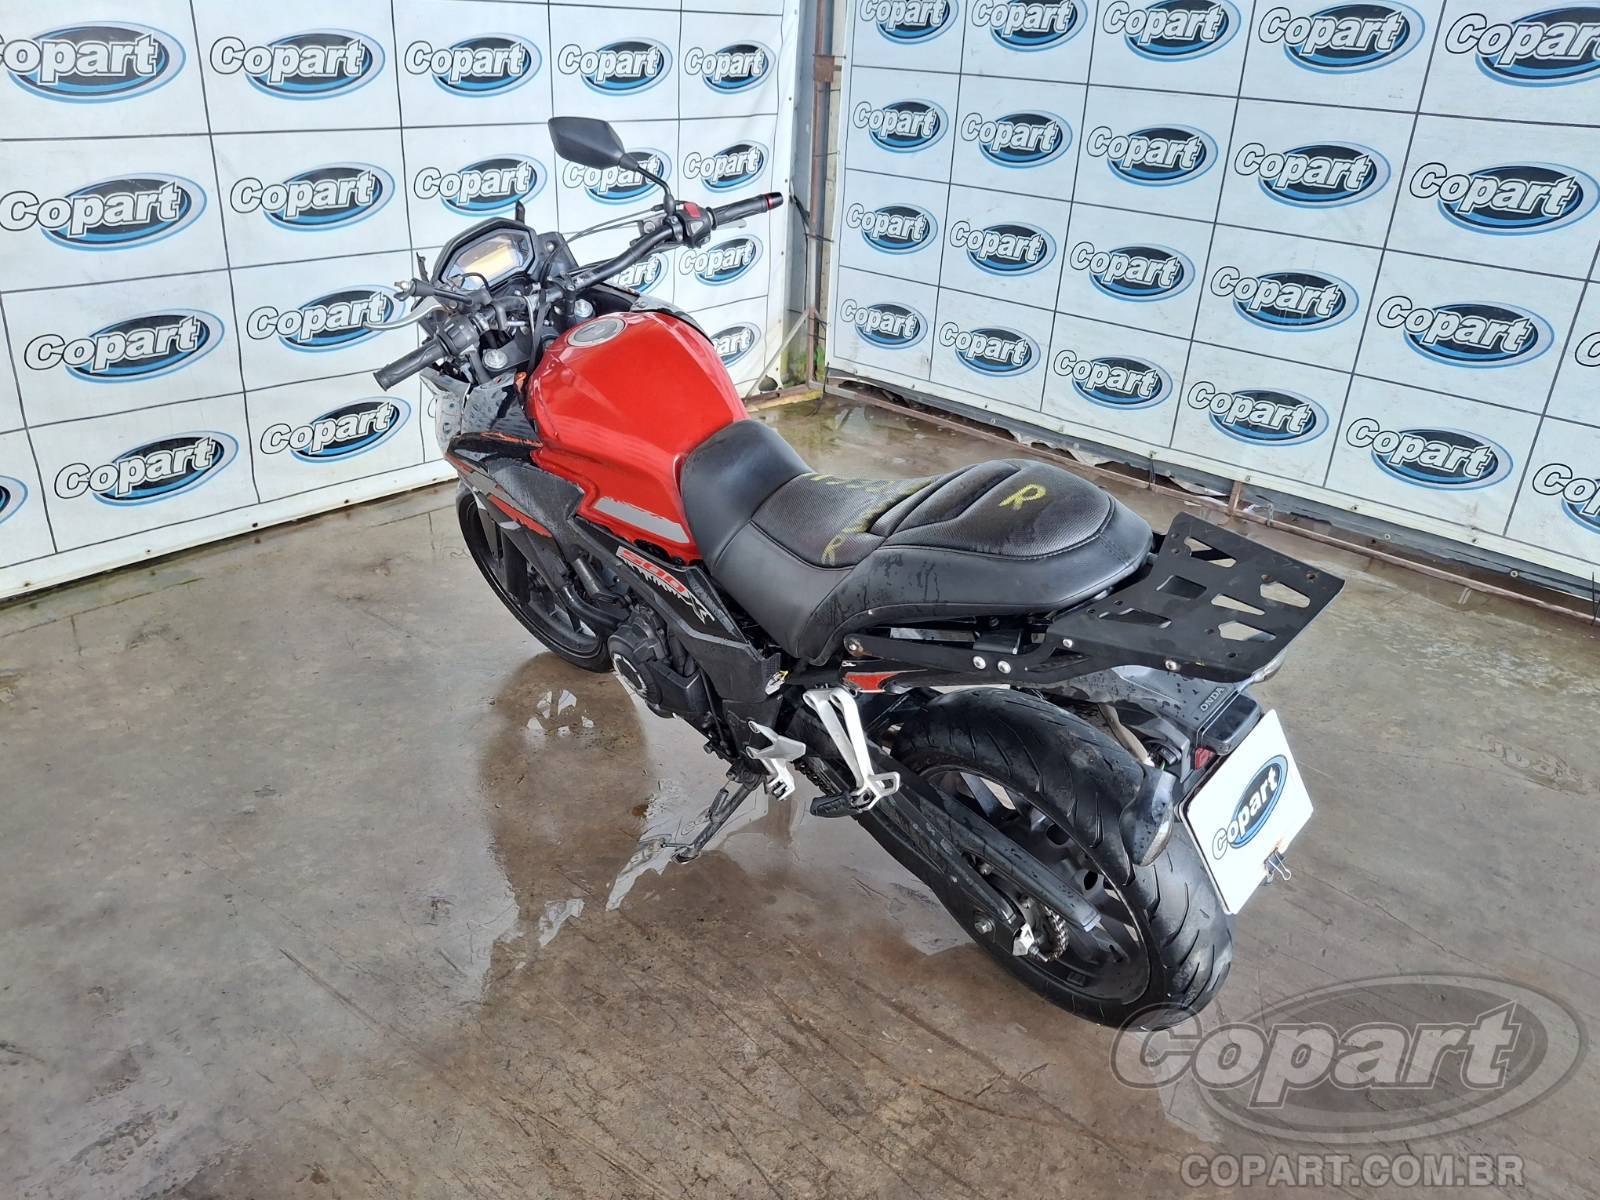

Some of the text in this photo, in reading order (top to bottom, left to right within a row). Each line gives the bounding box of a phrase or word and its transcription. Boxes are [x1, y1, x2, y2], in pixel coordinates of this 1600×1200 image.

[860, 0, 946, 31] Copart
[972, 0, 1075, 37] Copart
[1103, 1, 1224, 45] Copart
[1258, 7, 1404, 56] Copart
[0, 34, 157, 84] opart
[210, 36, 368, 84] Copart
[404, 40, 527, 84] Copart
[558, 43, 665, 82] Copart
[1445, 13, 1600, 67] Copar
[684, 47, 766, 81] Copart
[853, 101, 938, 138] Copart
[960, 112, 1058, 153] Copart
[683, 148, 760, 185] Copart
[1086, 126, 1203, 169] Copart
[1234, 143, 1374, 191] Copart
[230, 168, 376, 219] Copart
[414, 159, 533, 203] Copart
[1409, 162, 1579, 217] Copart
[0, 182, 182, 237] Copart
[846, 202, 929, 242] Copart
[679, 239, 755, 279] Copart
[949, 220, 1045, 263] Copart
[1070, 241, 1182, 288] Copart
[606, 255, 657, 286] art
[1210, 265, 1342, 317] Copart
[247, 291, 388, 340] Copart
[840, 298, 919, 340] Copart
[1377, 294, 1534, 354] Copart
[24, 315, 202, 373] Copart
[714, 328, 750, 355] art
[938, 321, 1031, 367] Copart
[1053, 349, 1160, 399] Copart
[260, 401, 399, 455] Copart
[1187, 381, 1313, 434] Copart
[54, 436, 216, 499] Copart
[1346, 417, 1495, 478] Copart
[1211, 766, 1280, 861] Copart
